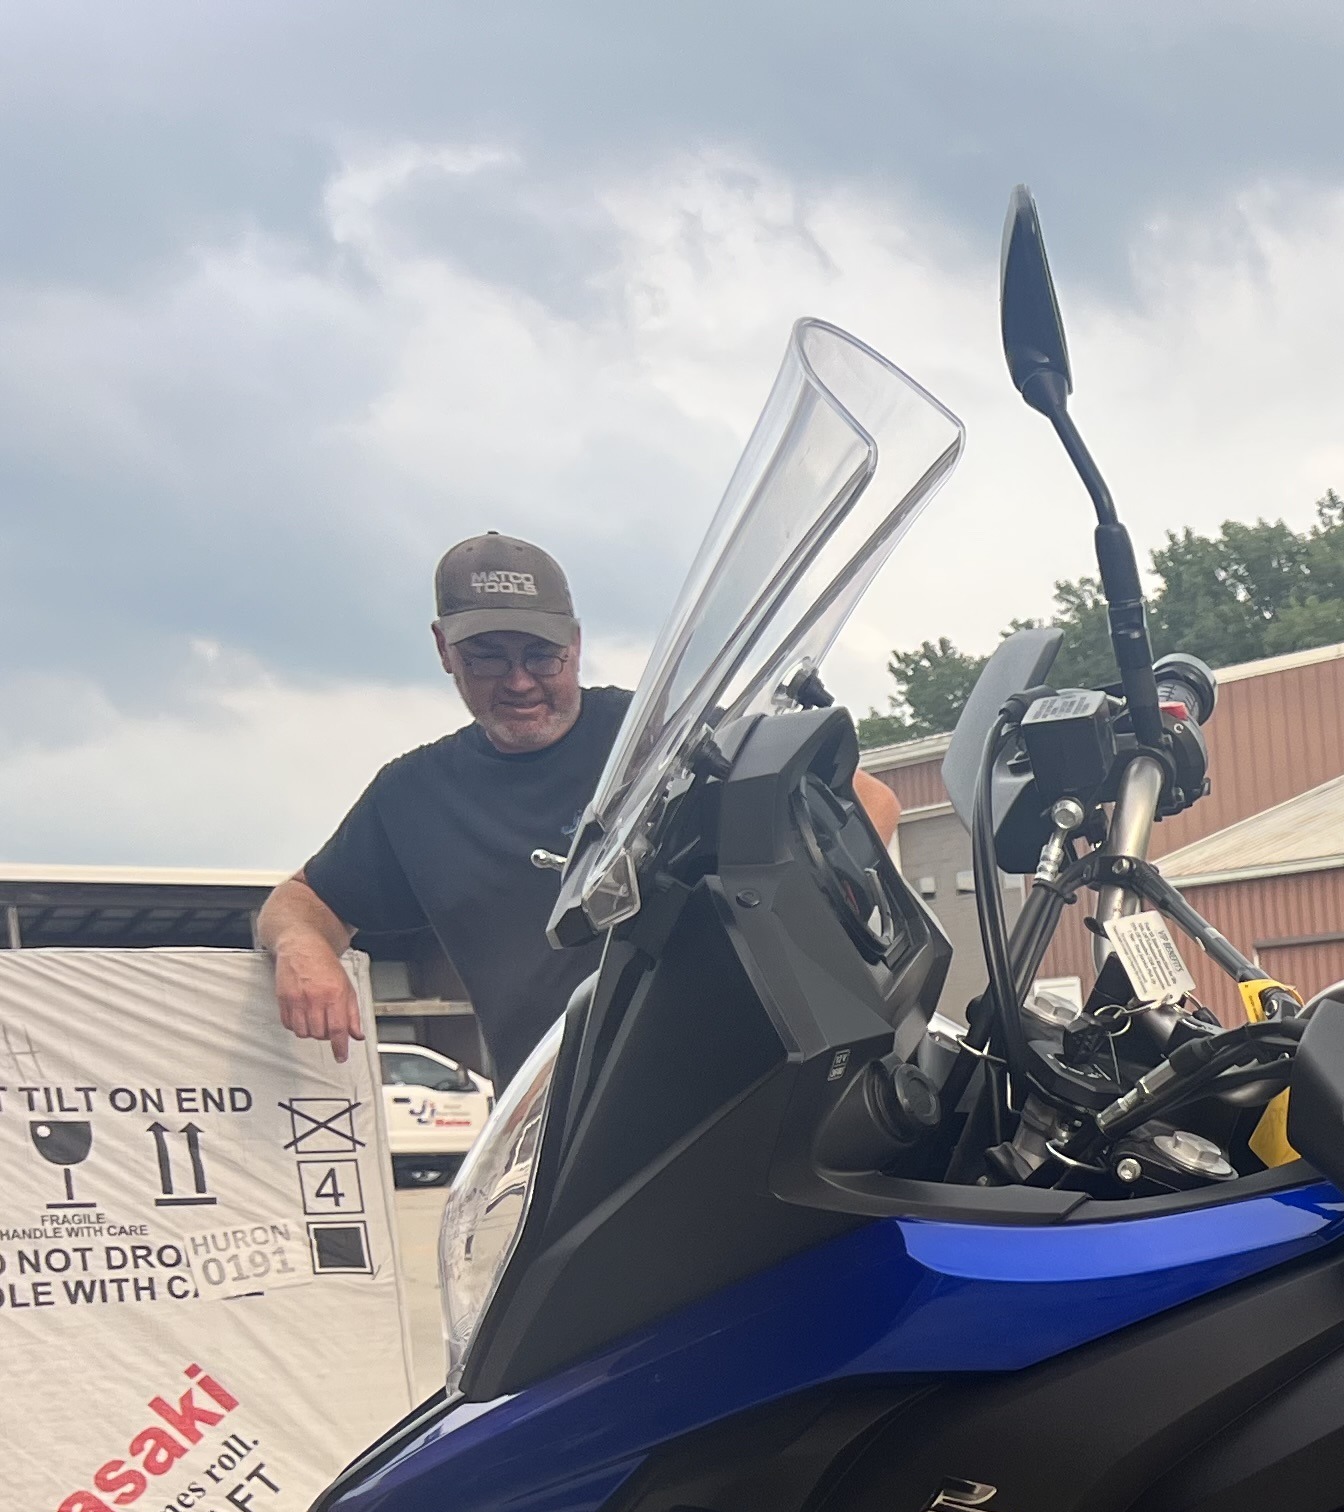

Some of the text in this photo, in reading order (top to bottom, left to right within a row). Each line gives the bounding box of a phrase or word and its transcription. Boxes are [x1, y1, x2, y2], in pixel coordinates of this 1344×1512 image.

[471, 571, 535, 585] MATCO
[471, 582, 538, 596] TOOLS
[18, 1086, 98, 1113] TILT
[109, 1087, 164, 1113] ON
[176, 1087, 253, 1113] END
[315, 1167, 345, 1207] 4
[1, 1223, 149, 1241] HANDLE WITH CARE
[40, 1213, 106, 1226] FRAGILE
[191, 1223, 292, 1256] HURON
[18, 1246, 94, 1275] NOT
[105, 1243, 191, 1270] DRO
[201, 1246, 296, 1286] 0191
[63, 1277, 156, 1305] WITH
[202, 1433, 260, 1486] roll.
